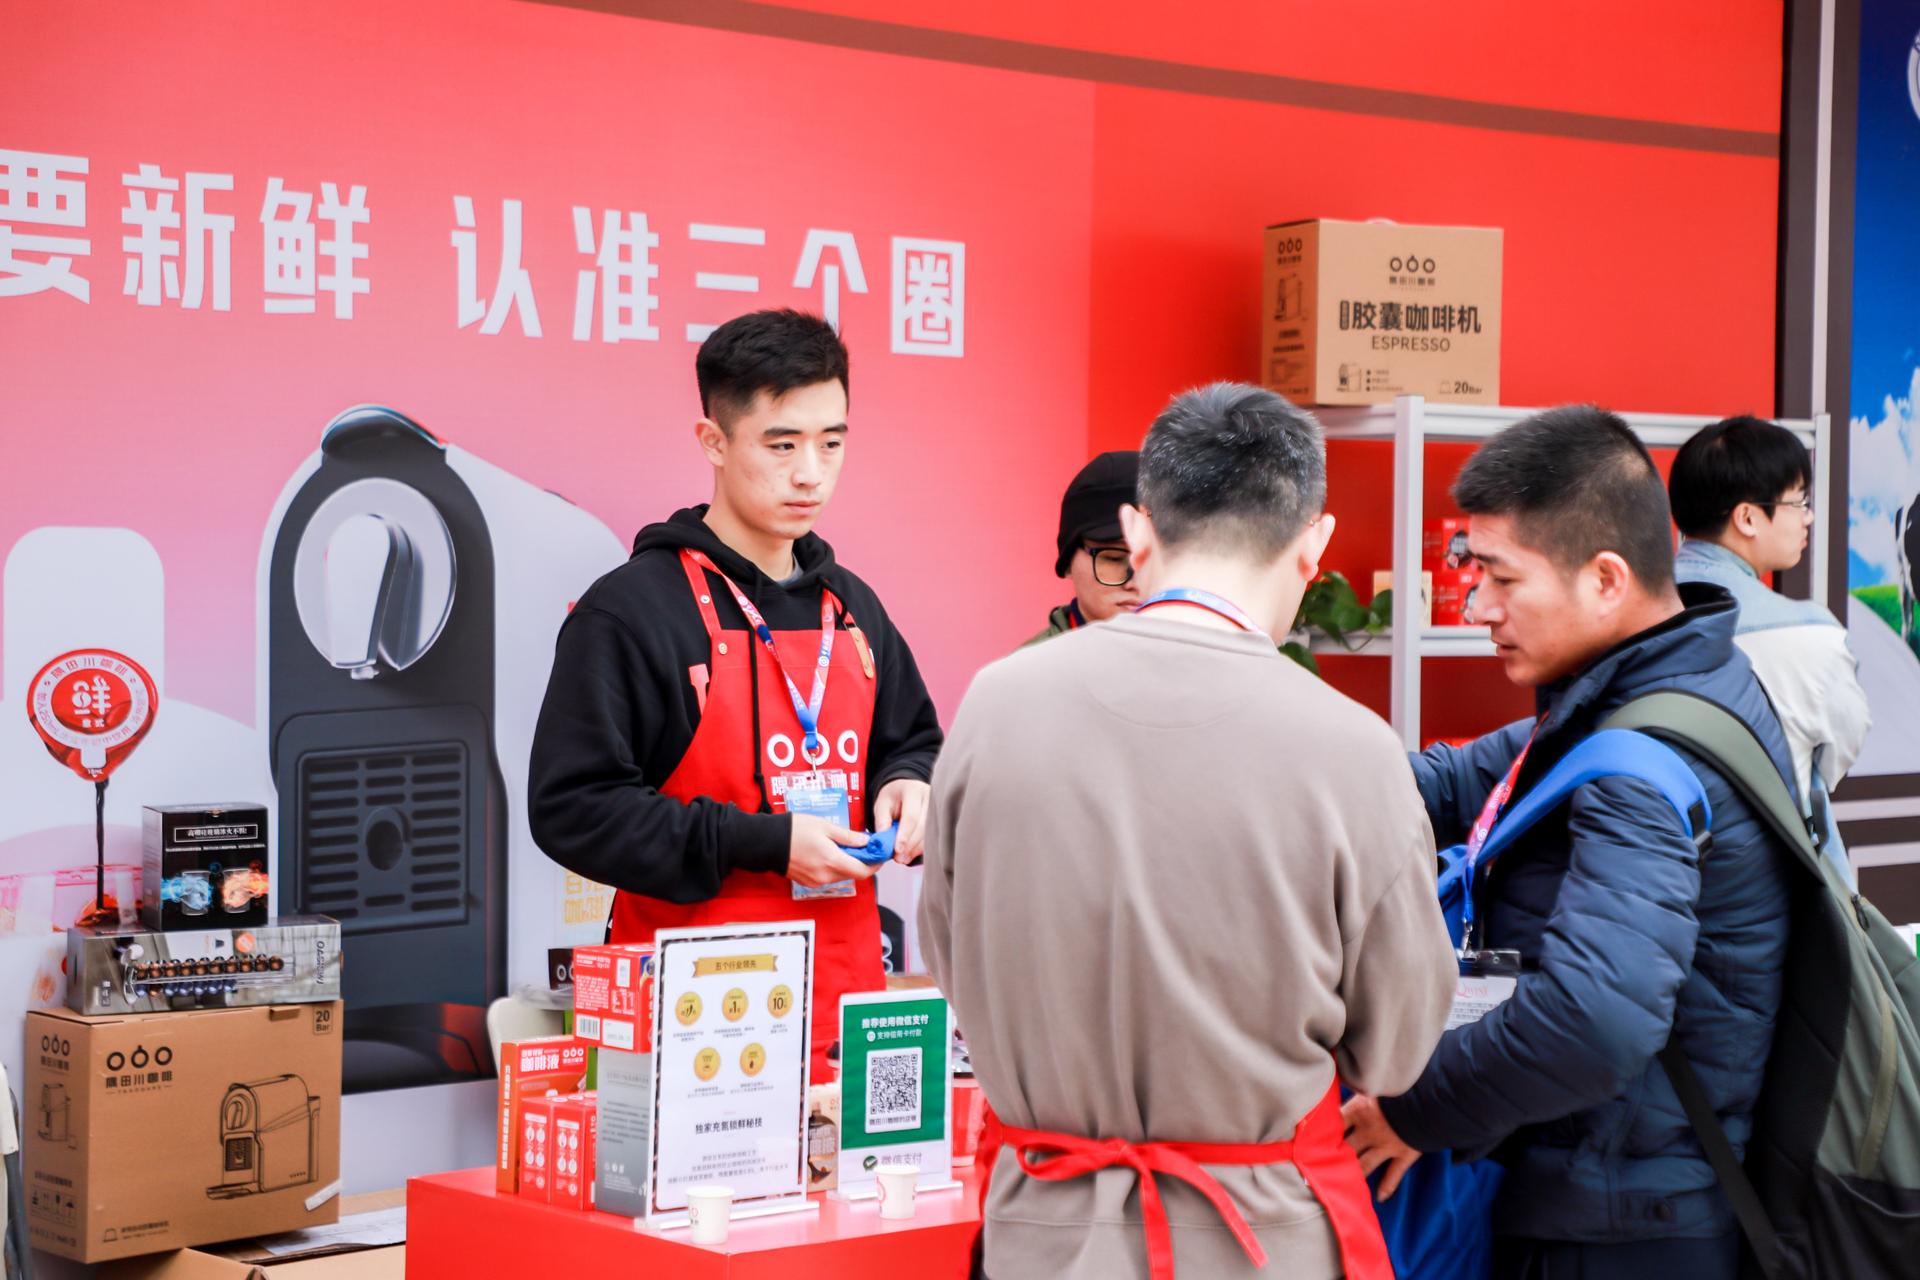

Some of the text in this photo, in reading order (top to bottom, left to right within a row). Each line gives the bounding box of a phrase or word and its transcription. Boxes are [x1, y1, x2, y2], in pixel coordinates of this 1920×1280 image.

[0, 149, 966, 358] 要新鲜 认准三个圈
[1352, 302, 1482, 334] 胶囊咖啡机
[1372, 335, 1451, 352] ESPRESSO
[315, 1010, 331, 1023] 20
[862, 1014, 928, 1029] 推荐使用微信支付
[316, 1022, 331, 1032] Bar
[106, 1071, 173, 1089] 隅田川咖啡
[881, 1152, 922, 1165] 微信支付
